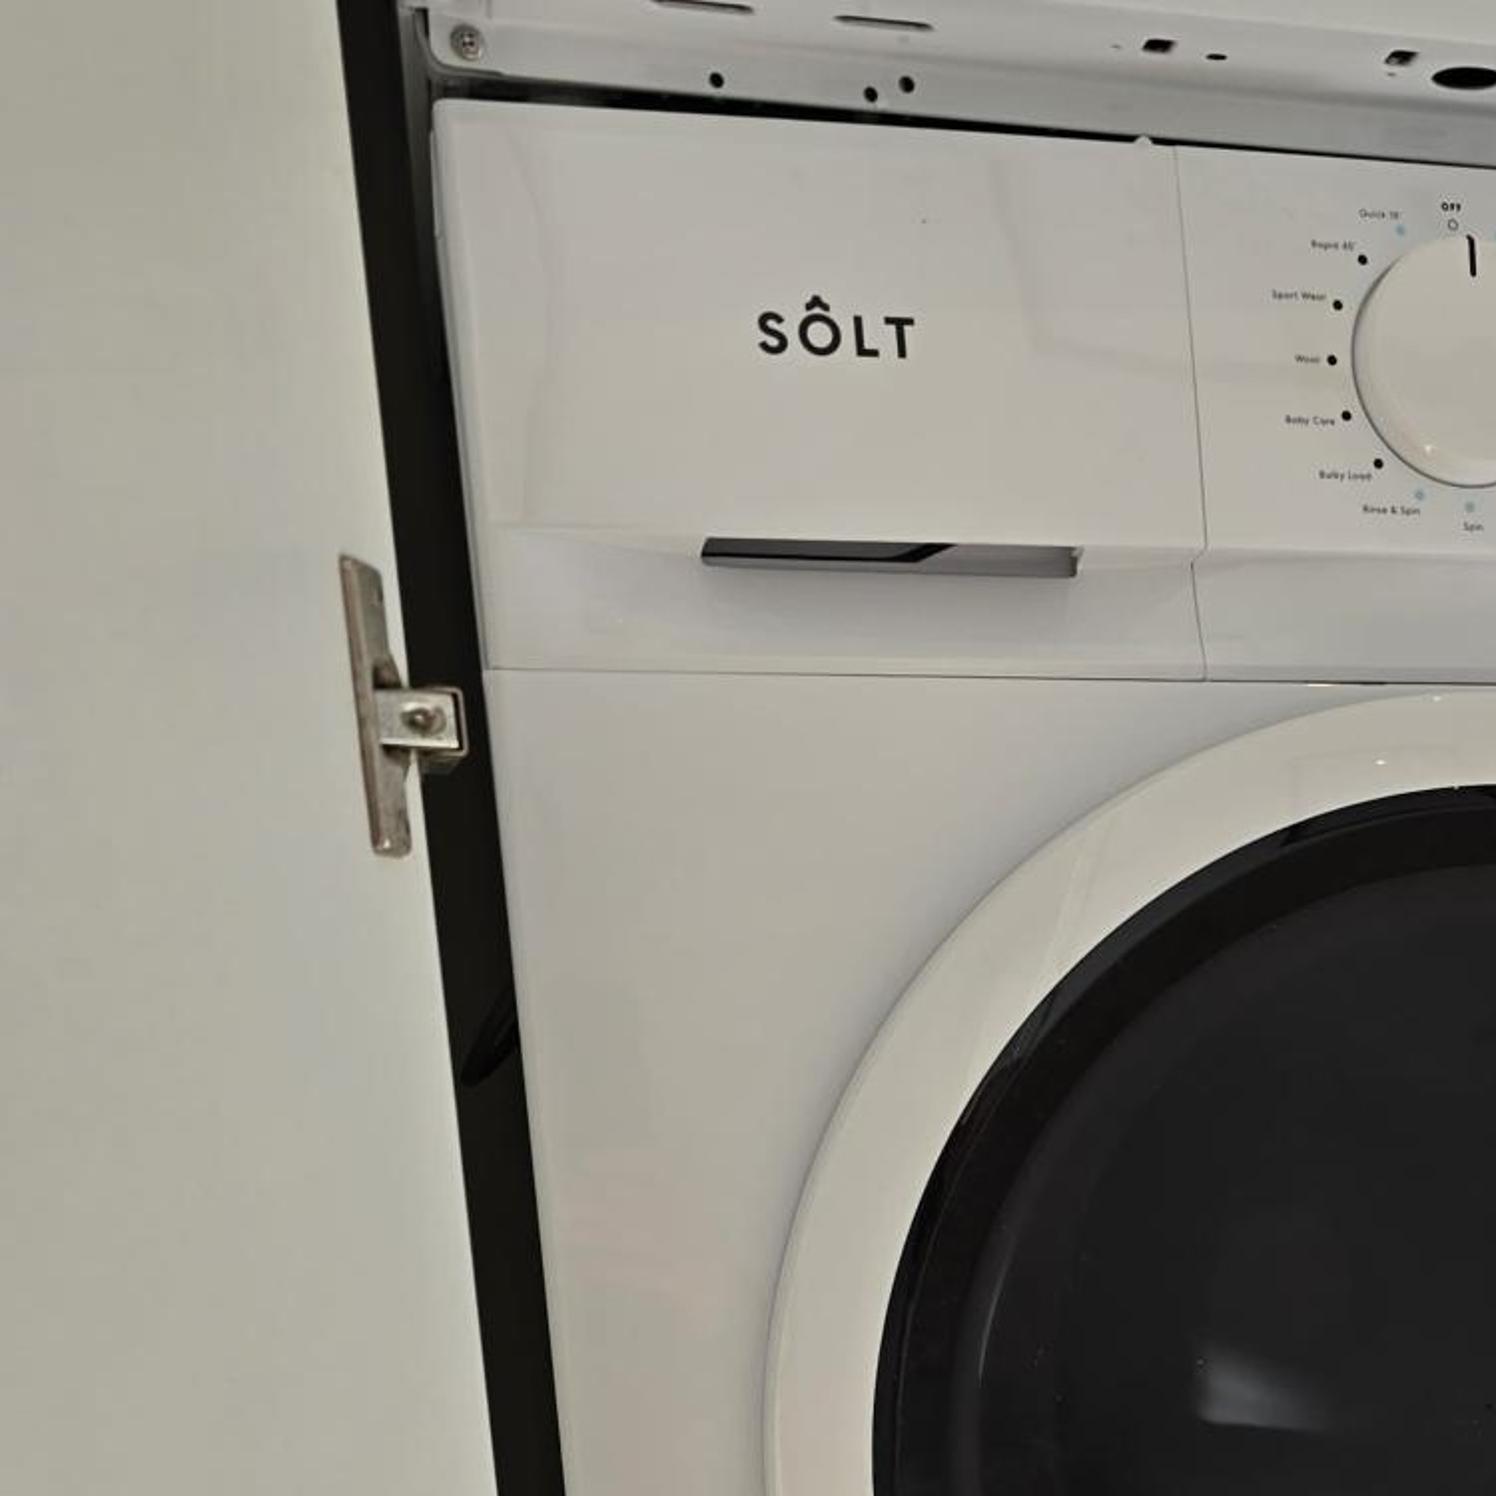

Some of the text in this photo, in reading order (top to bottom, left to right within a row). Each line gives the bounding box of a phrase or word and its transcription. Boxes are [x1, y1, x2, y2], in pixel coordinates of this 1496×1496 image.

[1272, 289, 1298, 301] Sport
[757, 295, 914, 359] SÔLT
[1464, 521, 1484, 532] Spin
